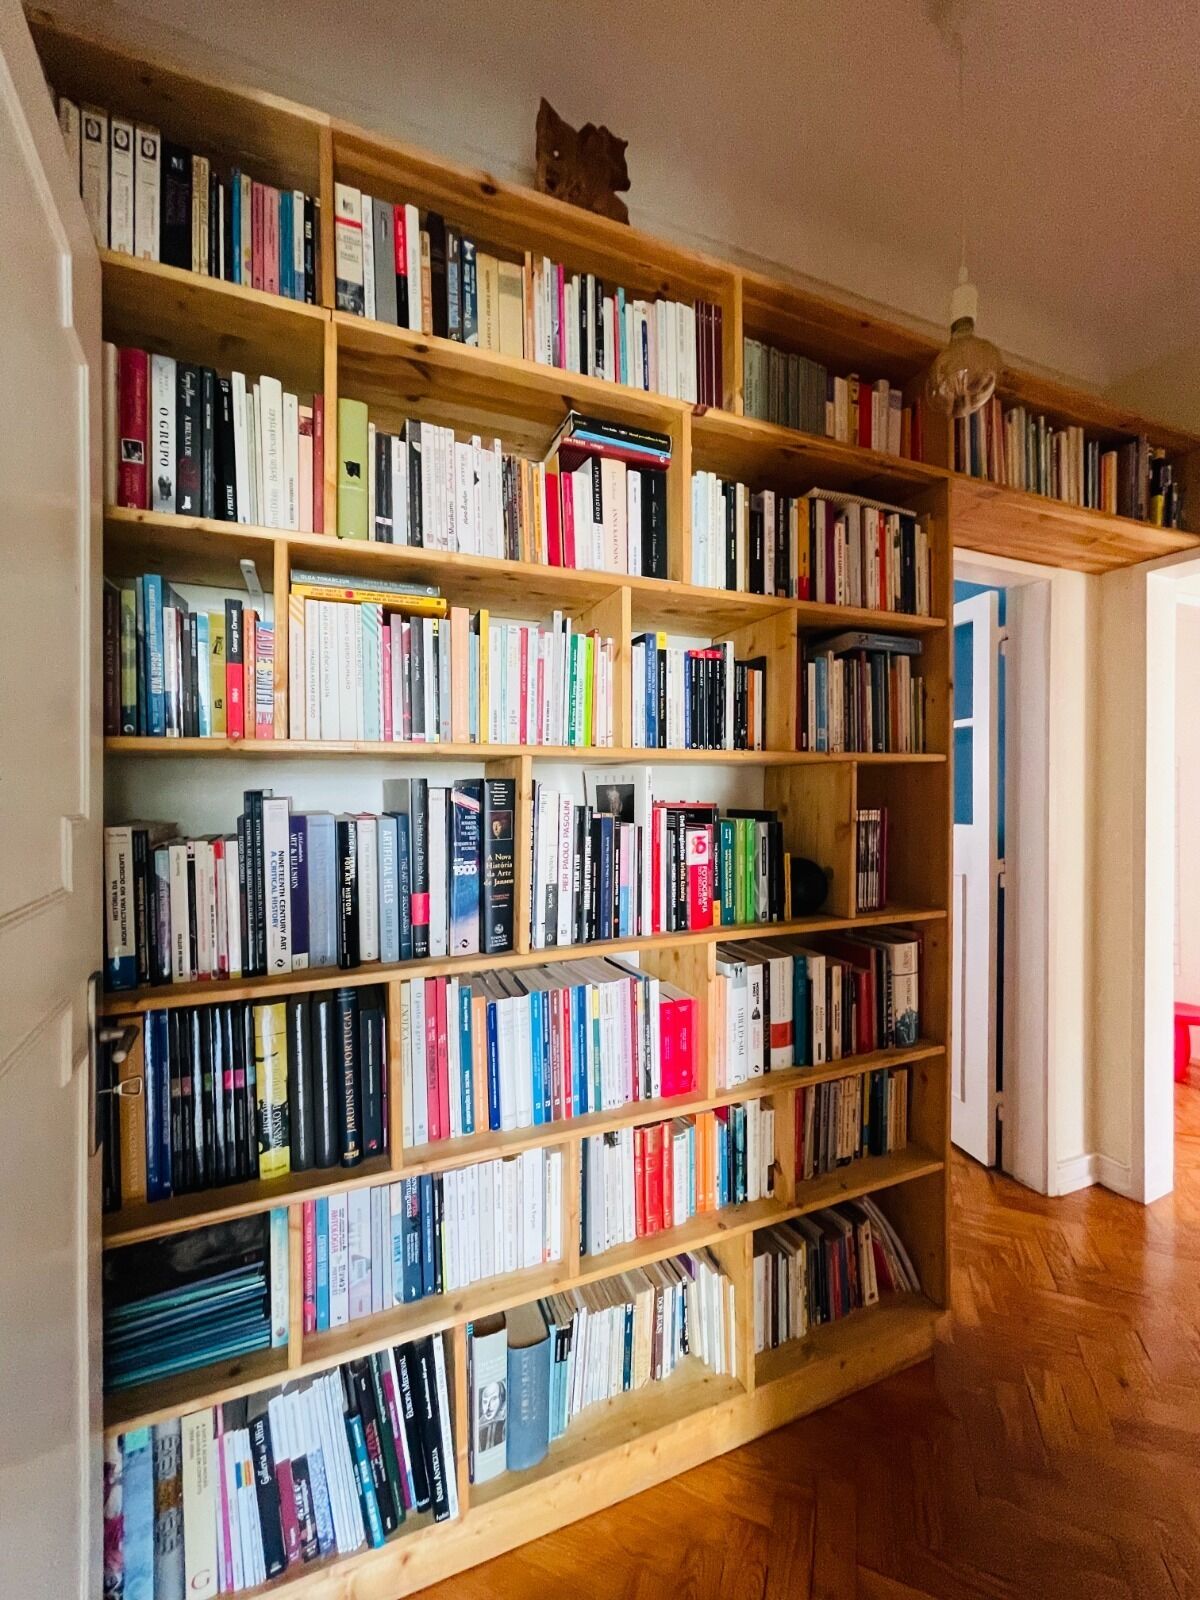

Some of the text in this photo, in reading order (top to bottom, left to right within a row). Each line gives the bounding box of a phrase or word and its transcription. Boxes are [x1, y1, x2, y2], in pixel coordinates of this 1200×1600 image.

[160, 407, 169, 416] O
[159, 420, 170, 467] GRUPO
[257, 627, 273, 705] ZADIE SMITH
[416, 824, 424, 843] History
[383, 830, 392, 876] ARTIFICIAL
[417, 845, 424, 854] of
[486, 861, 512, 869] História
[111, 880, 119, 921] HISTÓRIA DA
[120, 886, 126, 895] NO
[384, 879, 394, 904] HELLS
[402, 885, 408, 894] OF
[119, 897, 127, 946] ARQUITECTURA
[343, 1008, 356, 1134] JARDINS EM PORTUGAL
[399, 1355, 414, 1419] EUROPA MEDIEVAL
[259, 1455, 272, 1485] Galleria
[435, 1481, 444, 1502] INDIA
